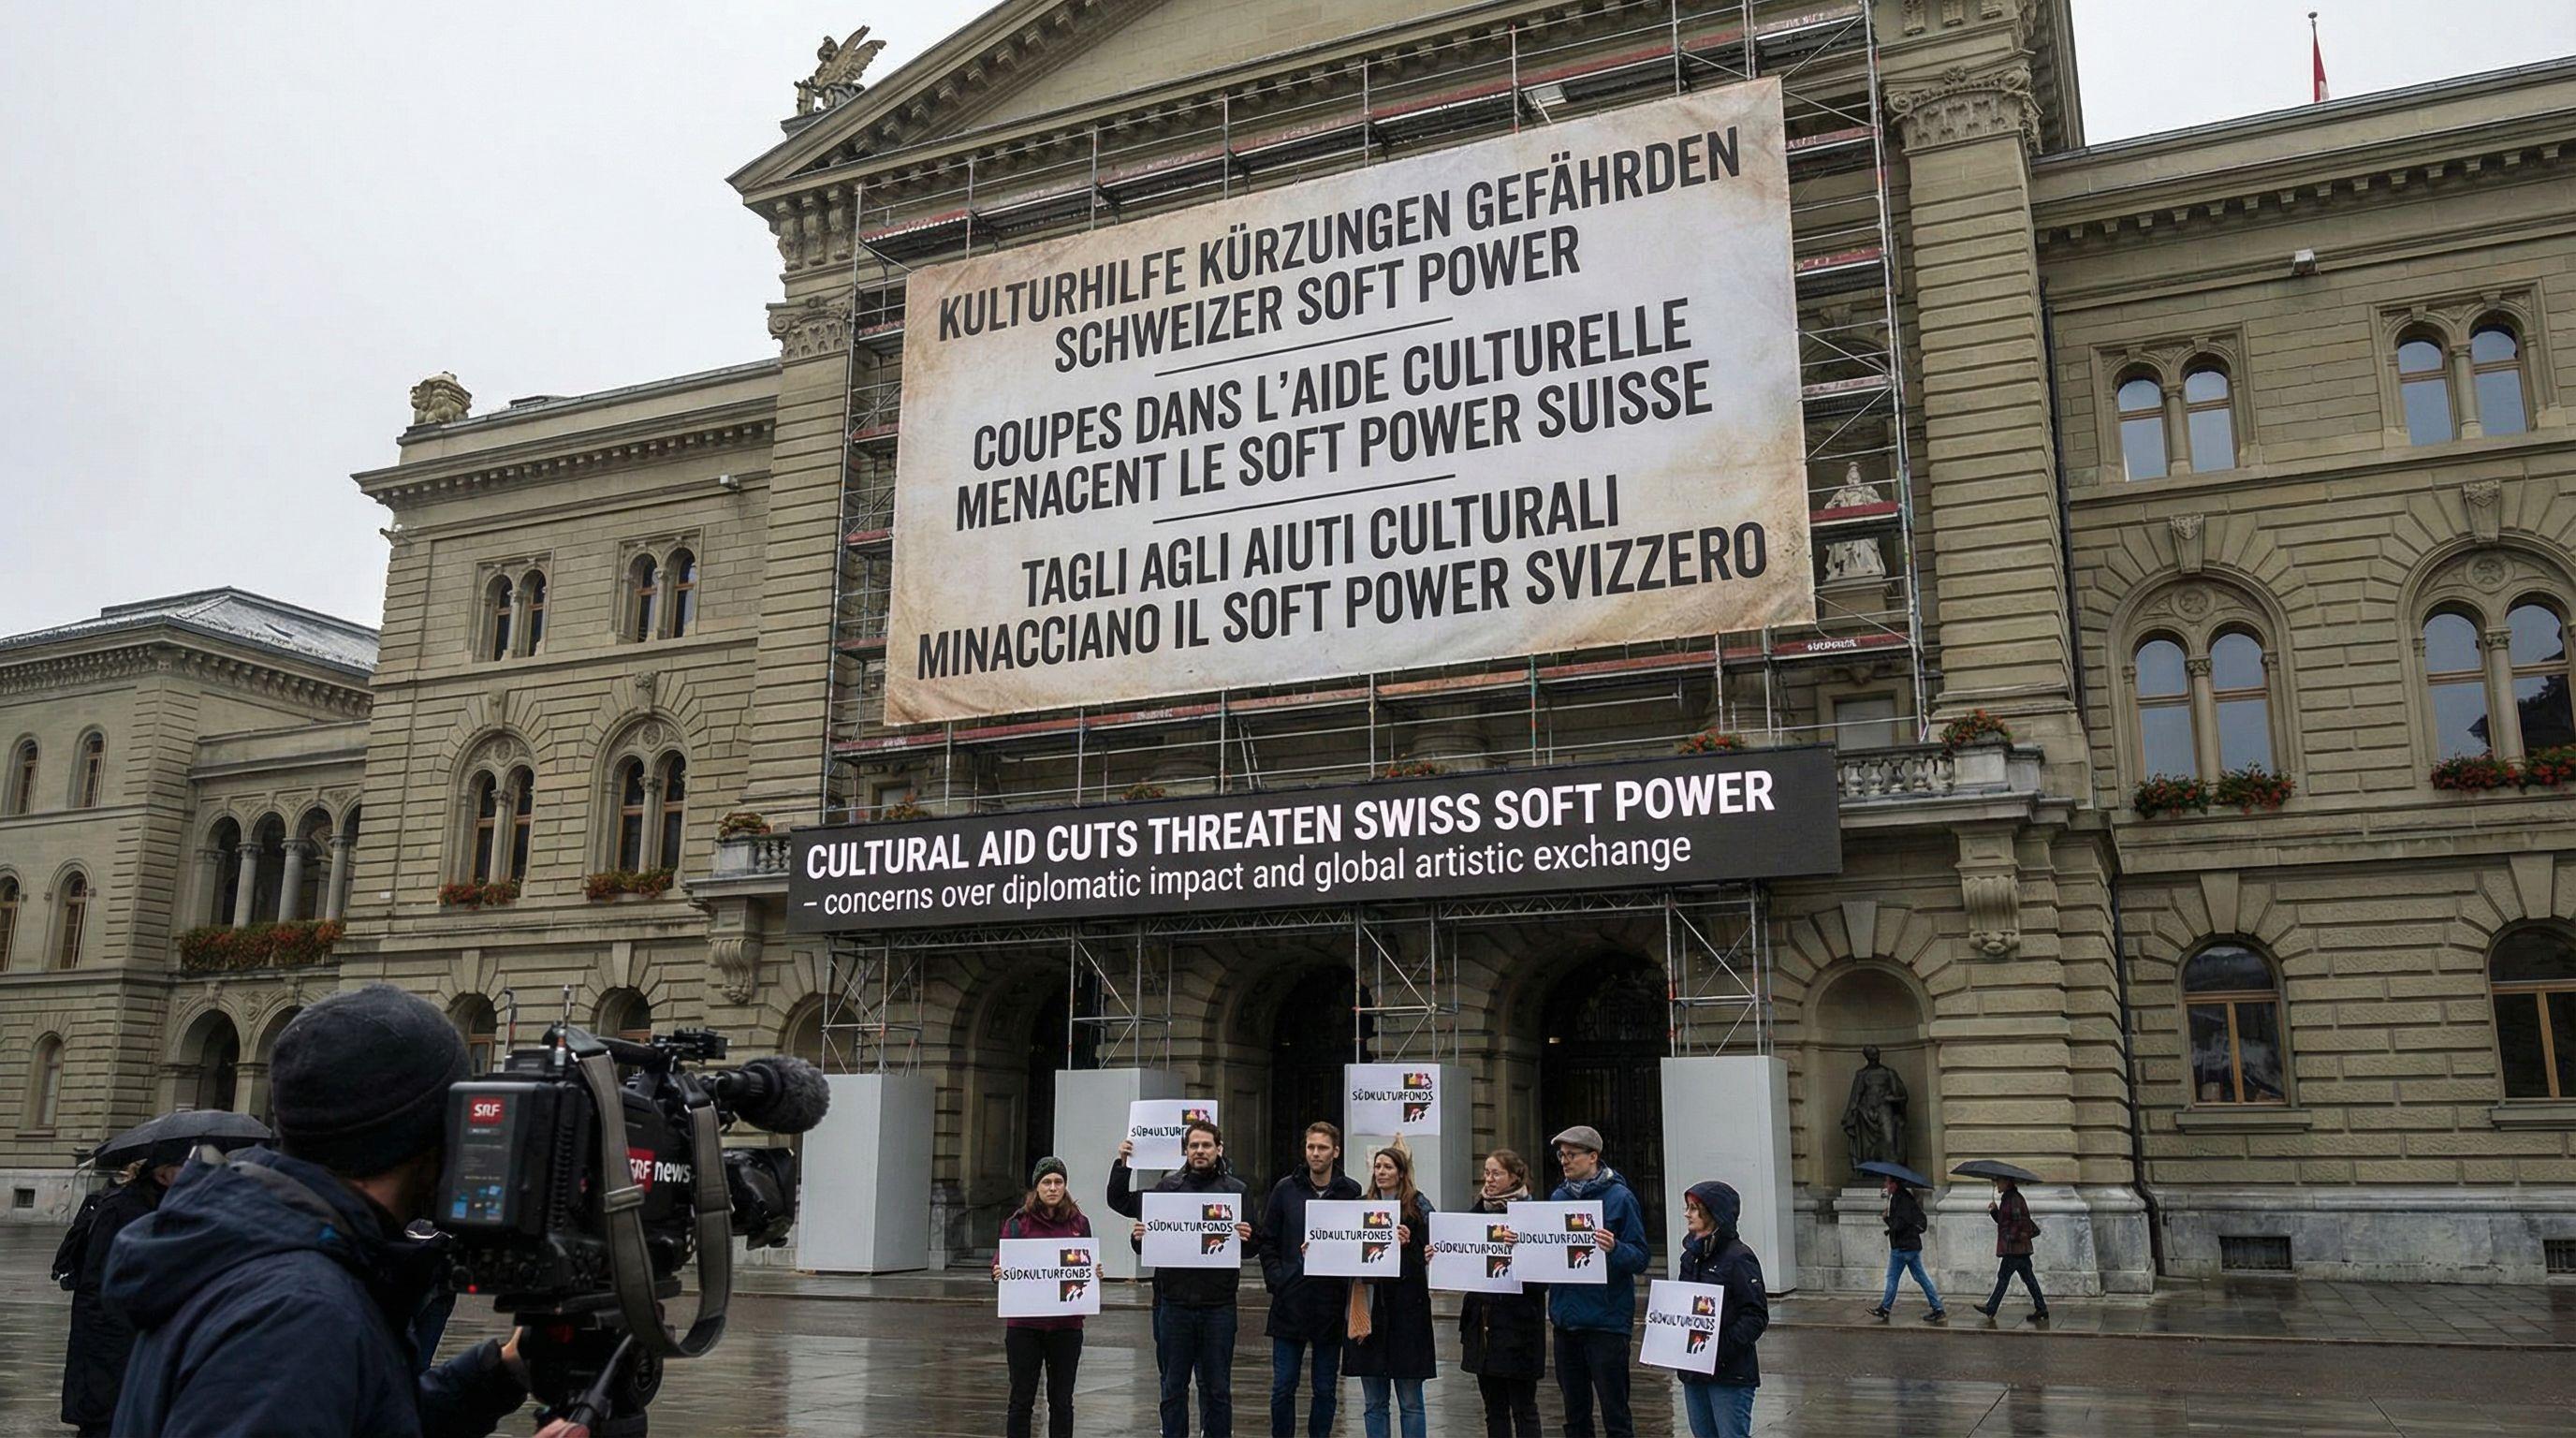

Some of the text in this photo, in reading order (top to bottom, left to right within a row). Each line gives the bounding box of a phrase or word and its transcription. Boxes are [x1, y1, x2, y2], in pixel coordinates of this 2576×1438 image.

[939, 125, 1740, 342] KULTURHILFE KÜRZUNGEN GEFÄHRDEN
[1055, 225, 1580, 374] SCHWEIZER SOFT POWER
[957, 359, 1713, 532] MENACENT LE SOFT POWER SUISSE
[973, 402, 1122, 471] COUPES
[1135, 379, 1242, 445] DANS
[1403, 297, 1691, 396] CULTURELLE
[917, 521, 1767, 681] MINACCIANO IL SOFT POWER SVIZZERO
[1021, 474, 1618, 608] TAGLI AGLI AIUTI CULTURALI
[806, 770, 1776, 880] CULTURAL AID CUTS THREATEN SWISS SOFT POWER
[824, 888, 933, 916] concerns
[941, 883, 996, 908] over
[1003, 870, 1141, 910] diplomatic
[1150, 862, 1244, 901] impact
[1252, 854, 1305, 889] and
[1314, 847, 1404, 892] global
[1415, 844, 1524, 879] artistic
[1533, 833, 1691, 872] exchange
[474, 1103, 502, 1117] SRF
[653, 1161, 692, 1183] news
